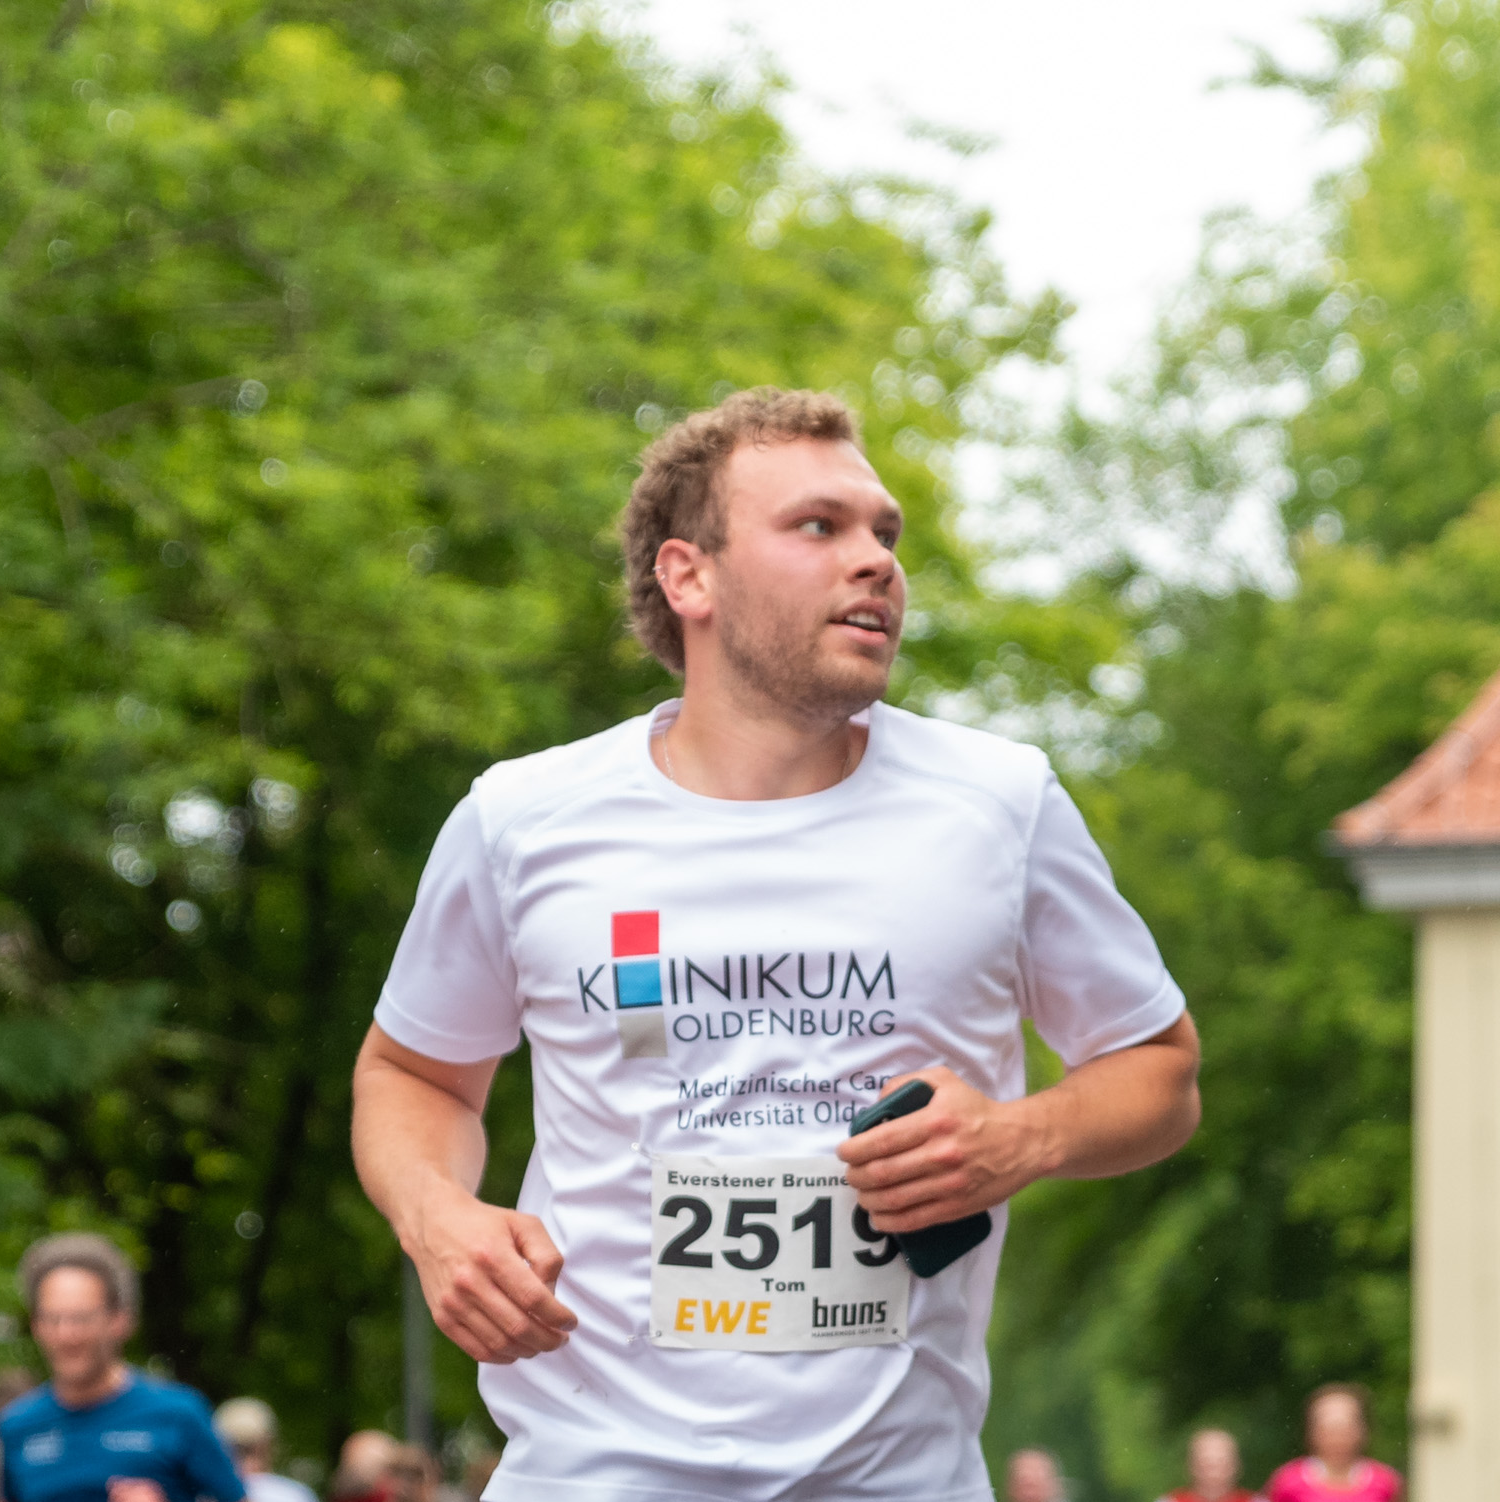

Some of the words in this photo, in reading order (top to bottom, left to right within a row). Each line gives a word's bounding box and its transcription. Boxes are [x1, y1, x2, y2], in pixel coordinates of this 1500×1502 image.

[577, 950, 896, 1013] KLINIKUM
[672, 1008, 896, 1042] OLDENBURG
[678, 1071, 842, 1100] Medizinischer
[677, 1103, 804, 1131] Universität
[667, 1170, 775, 1188] Everstener
[657, 1194, 902, 1271] 2519
[760, 1278, 806, 1293] Tom
[673, 1298, 772, 1335] EWE
[811, 1296, 888, 1328] bruns
